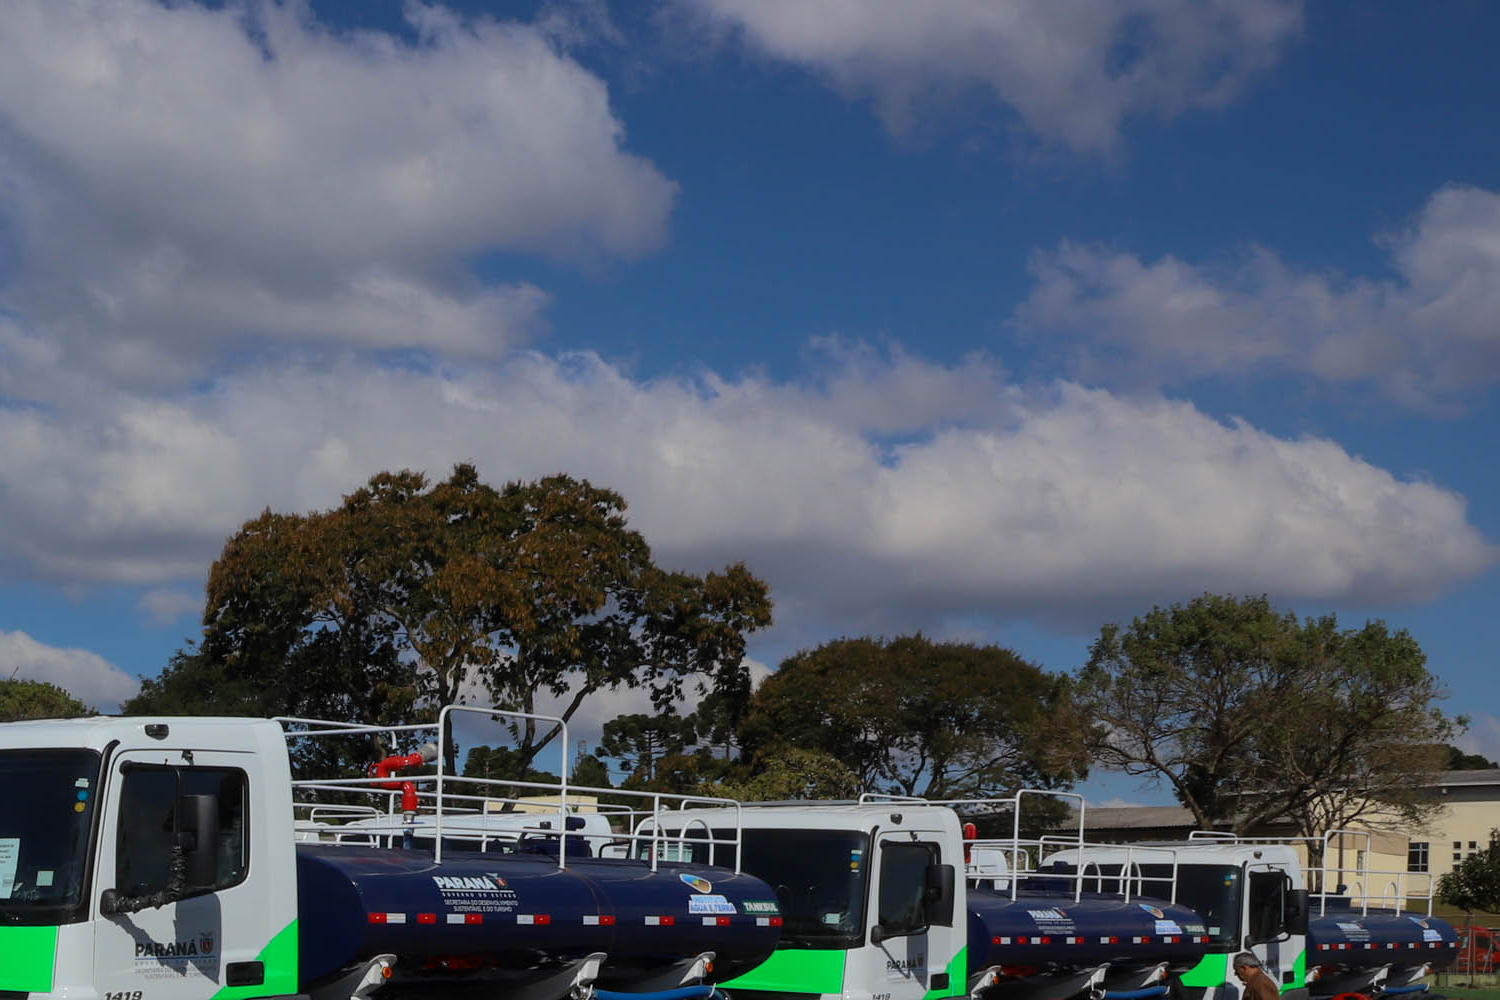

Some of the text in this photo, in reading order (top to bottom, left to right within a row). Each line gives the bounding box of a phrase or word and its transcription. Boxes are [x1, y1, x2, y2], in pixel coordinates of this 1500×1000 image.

[432, 876, 498, 890] PARANÁ
[743, 902, 778, 912] TANKSUL
[135, 939, 198, 957] PARANÁ
[872, 992, 891, 1000] 1419
